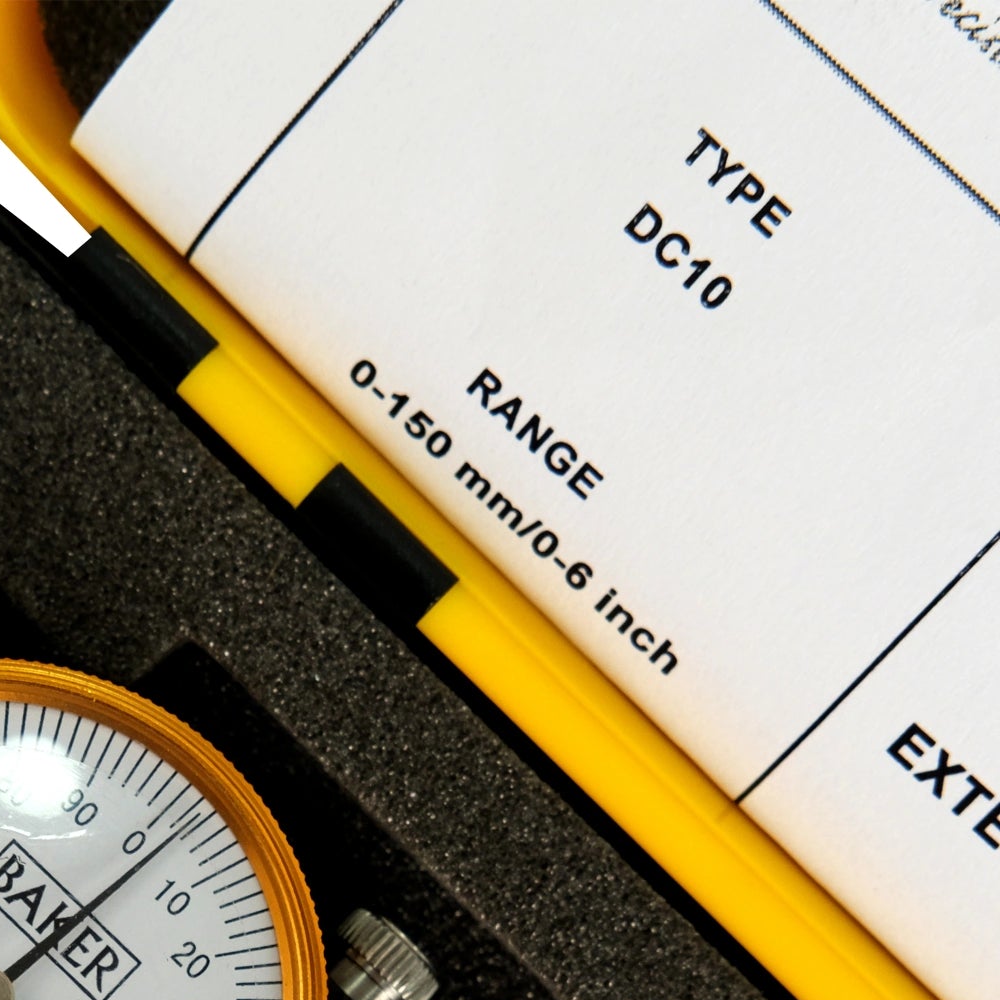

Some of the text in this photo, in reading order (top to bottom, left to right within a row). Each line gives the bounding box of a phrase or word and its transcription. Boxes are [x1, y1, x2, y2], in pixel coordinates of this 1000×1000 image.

[685, 127, 792, 239] TYPE
[624, 203, 733, 309] DC10
[466, 367, 604, 501] RANGE
[350, 359, 678, 675] 0-150 mm/0-6 inch
[61, 788, 99, 827] 90
[121, 830, 146, 855] 0
[154, 879, 191, 916] 10
[170, 941, 211, 979] 20
